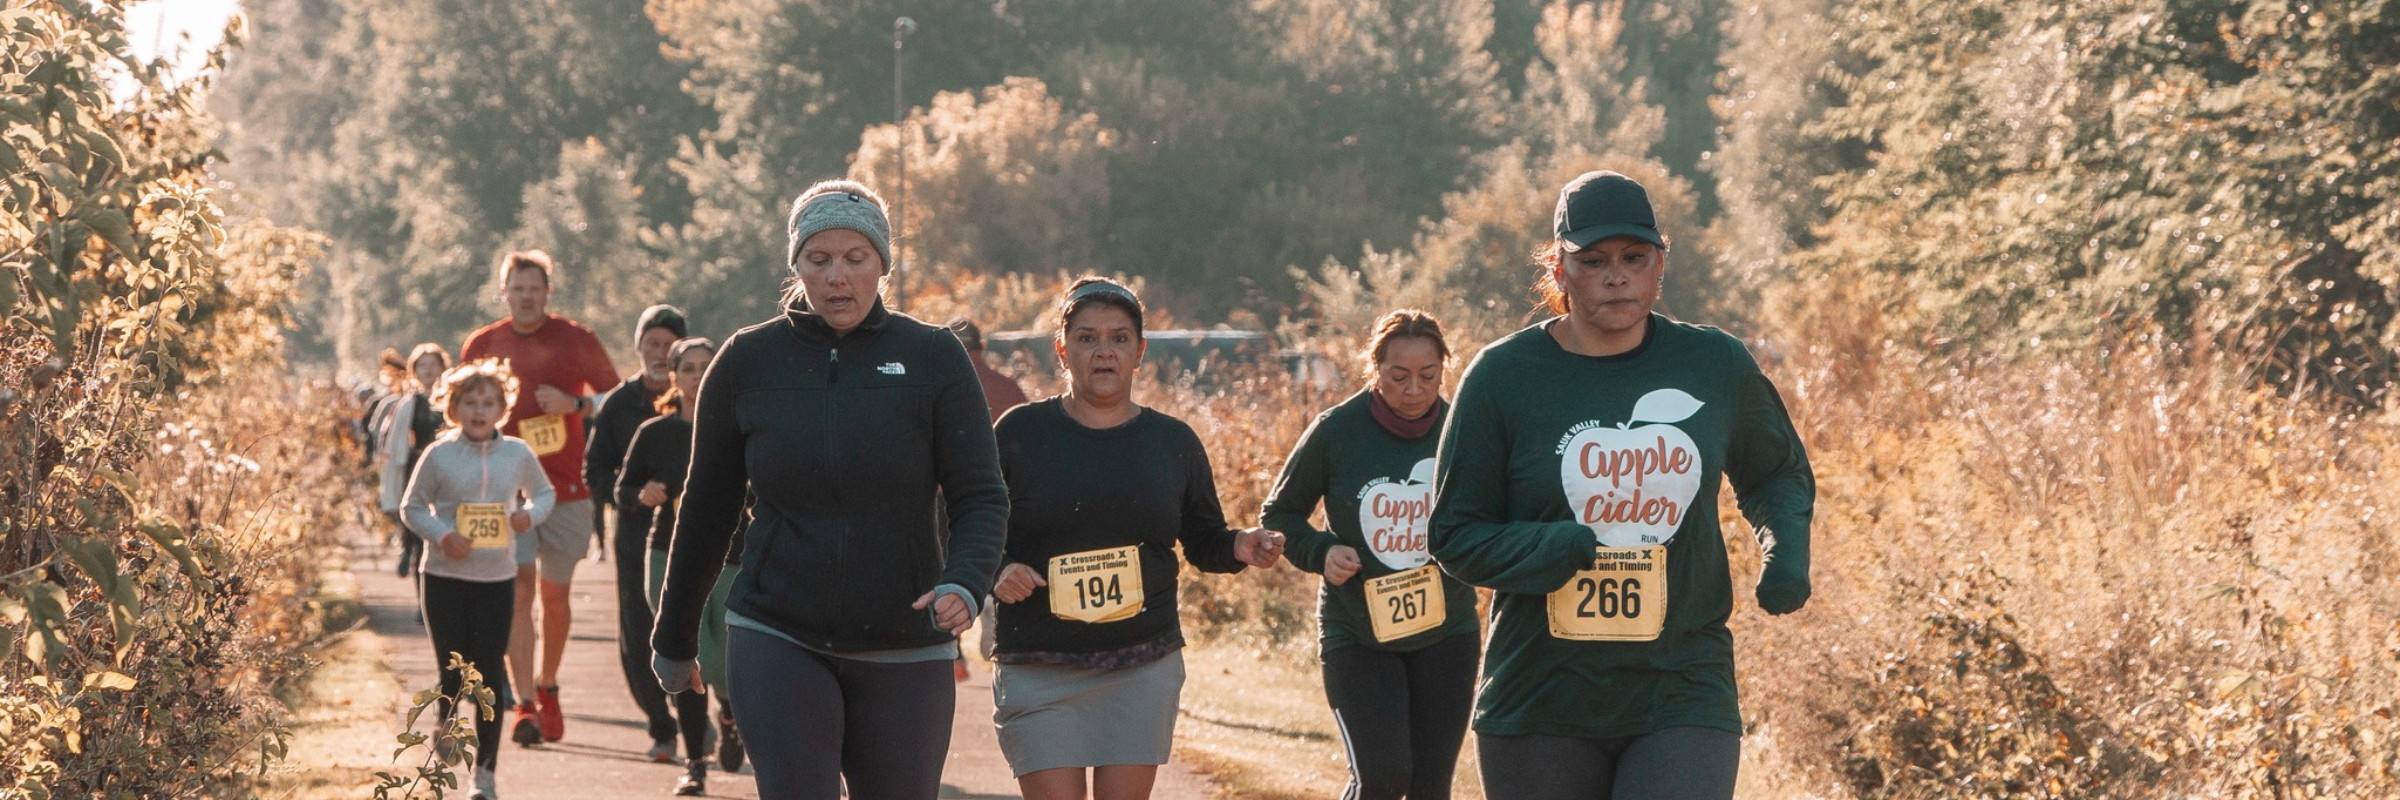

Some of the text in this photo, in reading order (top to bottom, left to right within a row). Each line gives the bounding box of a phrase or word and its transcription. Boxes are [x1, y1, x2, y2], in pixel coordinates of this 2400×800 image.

[534, 427, 558, 447] 121
[1555, 420, 1600, 455] SAUK VALLEY
[1372, 491, 1430, 526] Appl
[469, 518, 499, 538] 259
[1373, 526, 1427, 553] Cide
[1641, 534, 1659, 544] RUN
[1070, 552, 1115, 565] Crossroads
[1596, 551, 1637, 560] ssroads
[1060, 559, 1129, 575] Events and Timing
[1598, 562, 1616, 571] and
[1619, 561, 1652, 572] Timing
[1377, 584, 1398, 595] Events
[1399, 581, 1411, 590] and
[1385, 571, 1421, 585] Crossroads
[1074, 573, 1123, 610] 194
[1576, 577, 1641, 619] 266
[1389, 588, 1426, 624] 267
